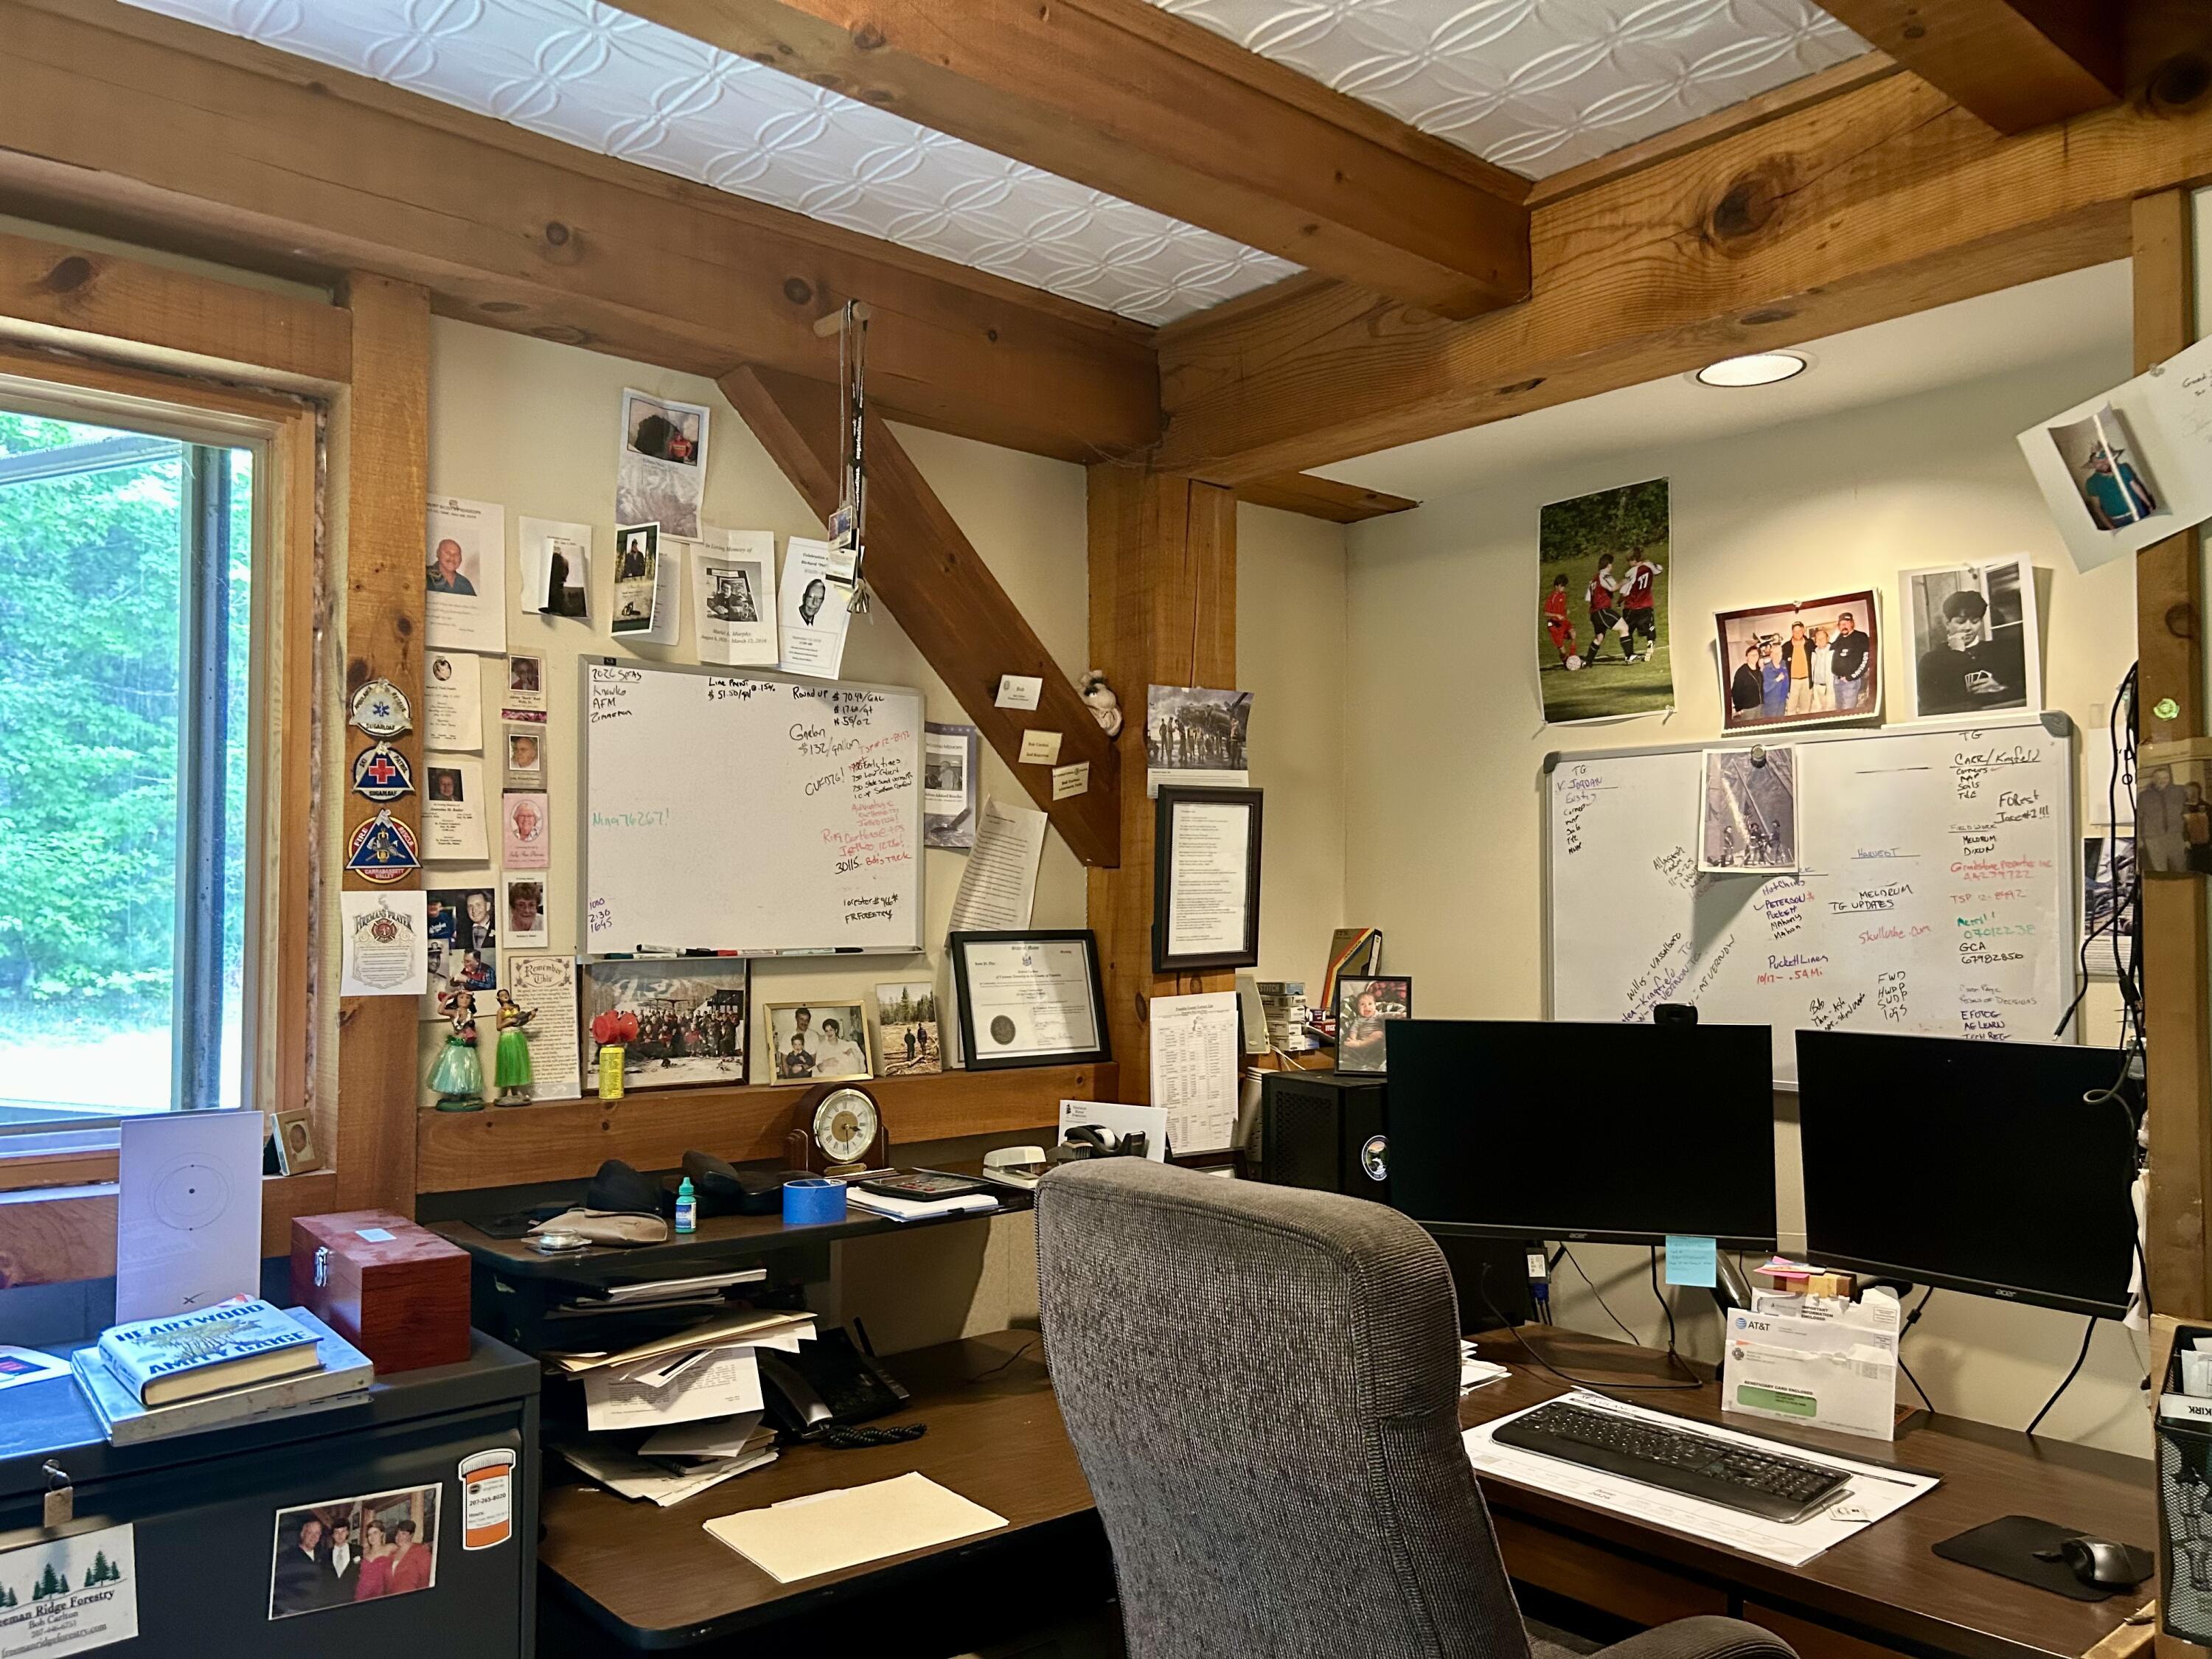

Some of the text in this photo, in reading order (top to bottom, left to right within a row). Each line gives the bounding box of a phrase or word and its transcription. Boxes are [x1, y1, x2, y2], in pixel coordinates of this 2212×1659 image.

[353, 827, 369, 847] FIRE
[1859, 884, 1913, 900] MELDRUM
[1959, 942, 1986, 952] GCA
[524, 964, 563, 978] Remember
[534, 973, 552, 984] This
[1994, 1288, 2017, 1297] acer
[114, 1304, 265, 1342] HEARTWOOD
[1748, 1321, 1770, 1331] AT&T
[36, 1602, 66, 1617] Ridge
[70, 1590, 114, 1607] Forestry
